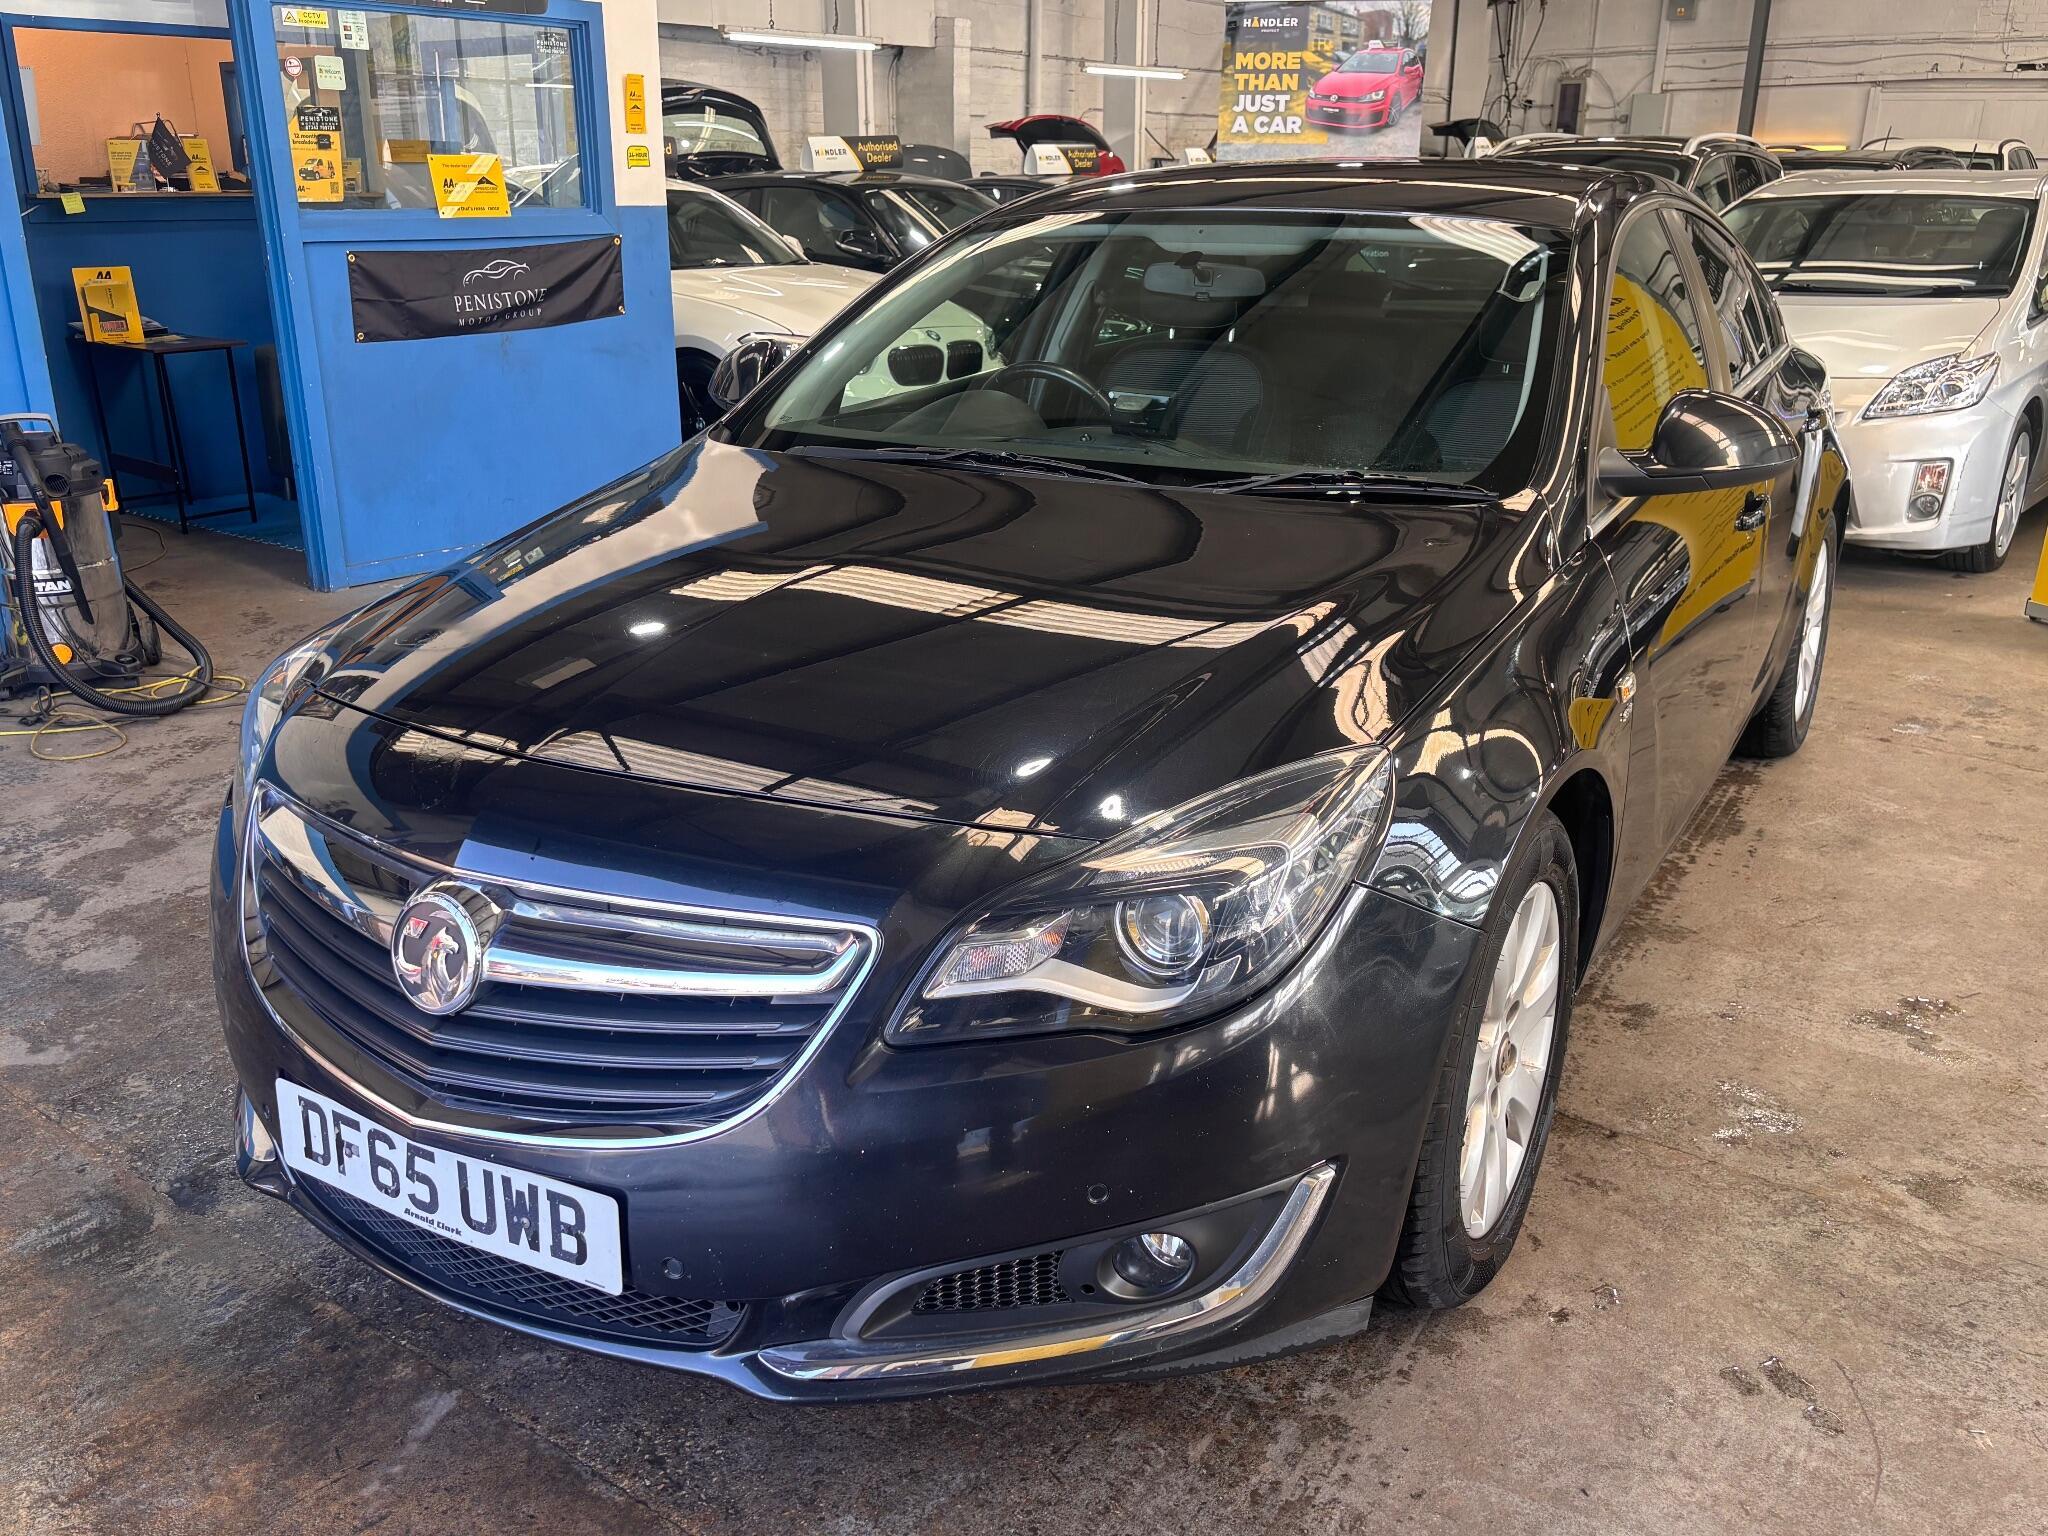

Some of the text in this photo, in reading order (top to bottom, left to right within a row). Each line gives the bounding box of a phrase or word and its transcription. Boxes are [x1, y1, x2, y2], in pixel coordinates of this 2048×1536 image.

[1243, 16, 1298, 27] HANDLER
[1235, 52, 1302, 70] MORE
[1234, 74, 1298, 91] THAN
[1232, 94, 1291, 112] JUST
[1230, 115, 1302, 133] A CAR
[814, 145, 847, 157] HANDLER
[858, 140, 898, 151] Authorised
[867, 152, 892, 163] Dealer
[1068, 149, 1097, 158] Authorised
[1074, 159, 1093, 168] Dealer
[443, 178, 454, 188] AA
[96, 270, 112, 279] AA
[453, 288, 548, 313] PENISTONE
[458, 308, 543, 327] MOTOR GROUP
[34, 580, 72, 592] TAN
[297, 1094, 588, 1266] DF65 UWB
[404, 1207, 435, 1226] Arnold
[436, 1220, 463, 1236] Clark
